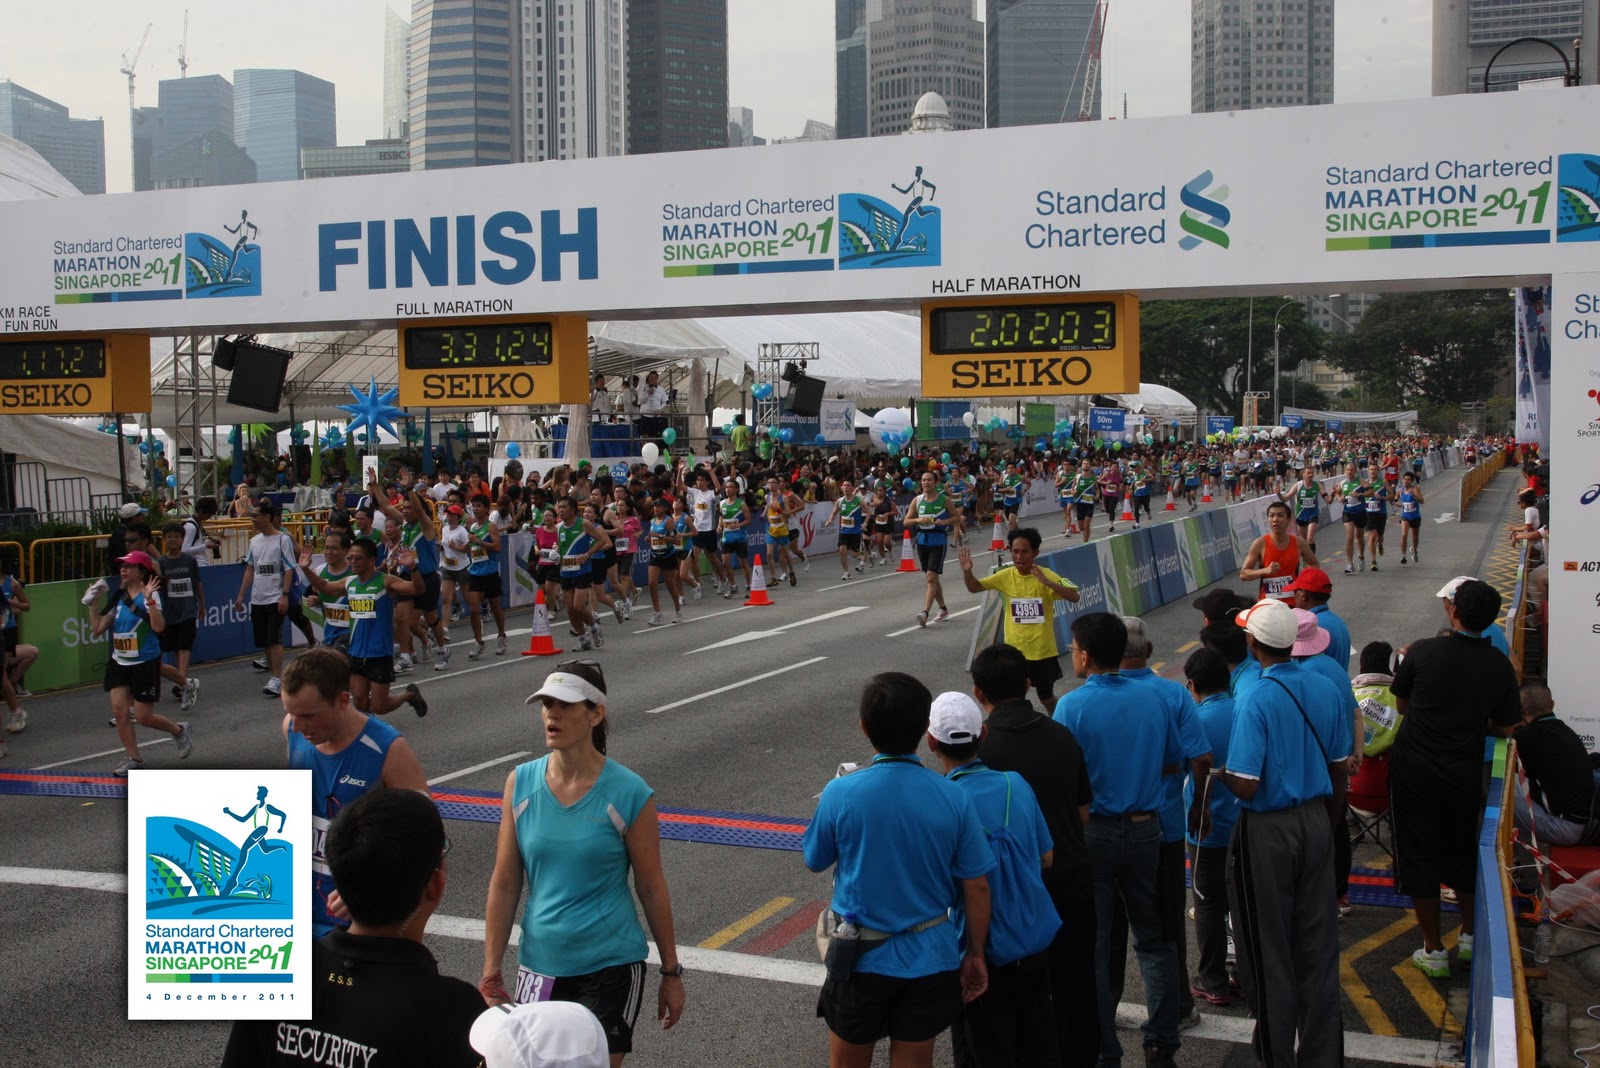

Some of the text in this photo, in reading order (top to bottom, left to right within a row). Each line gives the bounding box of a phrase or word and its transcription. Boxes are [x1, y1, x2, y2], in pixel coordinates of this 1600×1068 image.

[379, 151, 406, 160] HSBC
[1326, 155, 1552, 185] Standard Chartered
[662, 195, 834, 220] Standard Chartered
[1036, 186, 1165, 216] Standard
[1325, 185, 1476, 209] MARATHON
[1480, 181, 1552, 224] 2011
[662, 220, 777, 241] MARATHON
[1325, 208, 1477, 232] SINGAPORE
[54, 234, 182, 255] Standard Chartered
[781, 217, 834, 254] 2011
[1025, 219, 1165, 249] Chartered
[318, 207, 598, 292] FINISH
[663, 240, 779, 261] SINGAPORE
[54, 255, 140, 273] MARATHON
[143, 253, 182, 285] 2011
[54, 273, 142, 290] SINGAPORE
[932, 275, 1081, 293] HALF MARATHON
[19, 306, 51, 318] RACE
[396, 299, 513, 316] FULL MARATHON
[1575, 294, 1600, 313] St
[5, 319, 58, 331] FUN RUN
[1565, 320, 1600, 339] Ch
[951, 356, 1092, 389] SEIKO
[1, 383, 92, 407] SEIKO
[423, 372, 535, 399] SEIKO
[348, 778, 366, 787] asics
[277, 1022, 378, 1068] SECURITY
